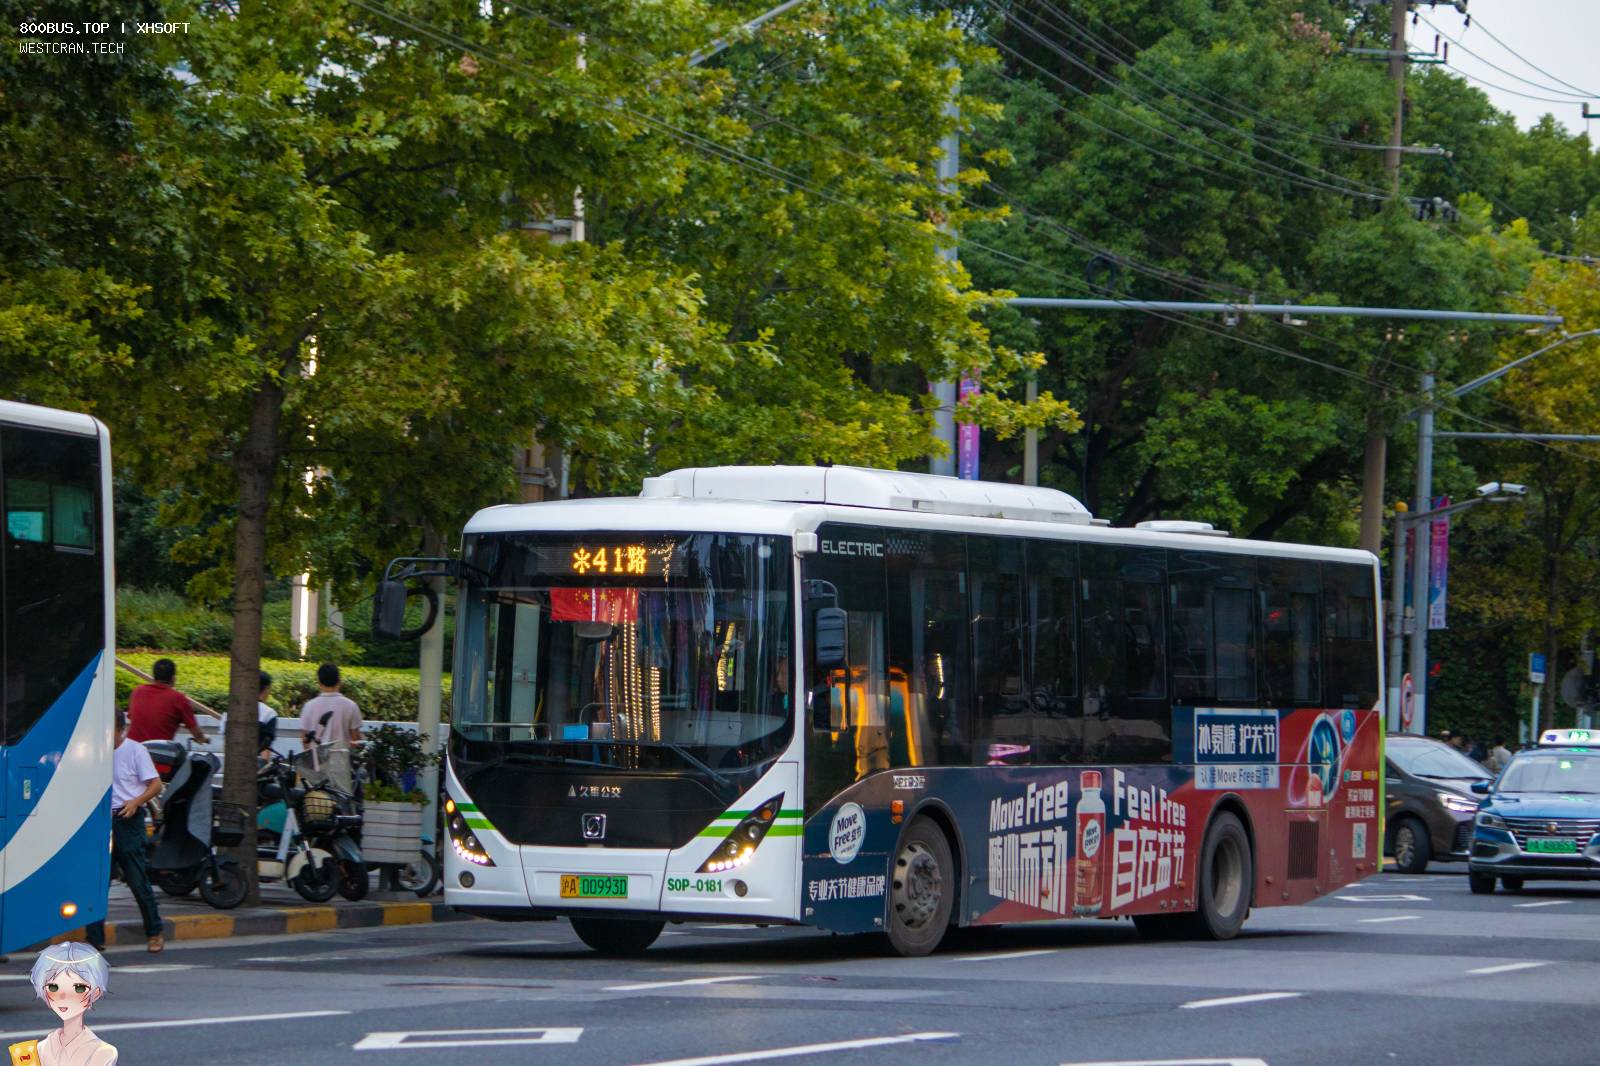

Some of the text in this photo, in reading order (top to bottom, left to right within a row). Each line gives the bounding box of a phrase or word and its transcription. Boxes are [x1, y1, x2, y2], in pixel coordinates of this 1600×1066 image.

[820, 539, 884, 557] ELECTRIC
[1240, 721, 1276, 755] 护关节
[989, 780, 1068, 832] Move Free
[1113, 768, 1187, 827] Feel Free
[836, 813, 858, 834] Move
[988, 826, 1068, 915] 随心而动
[1110, 820, 1187, 911] 自在益节
[582, 878, 627, 895] 00993D
[808, 875, 886, 902] 专业关节健康品牌
